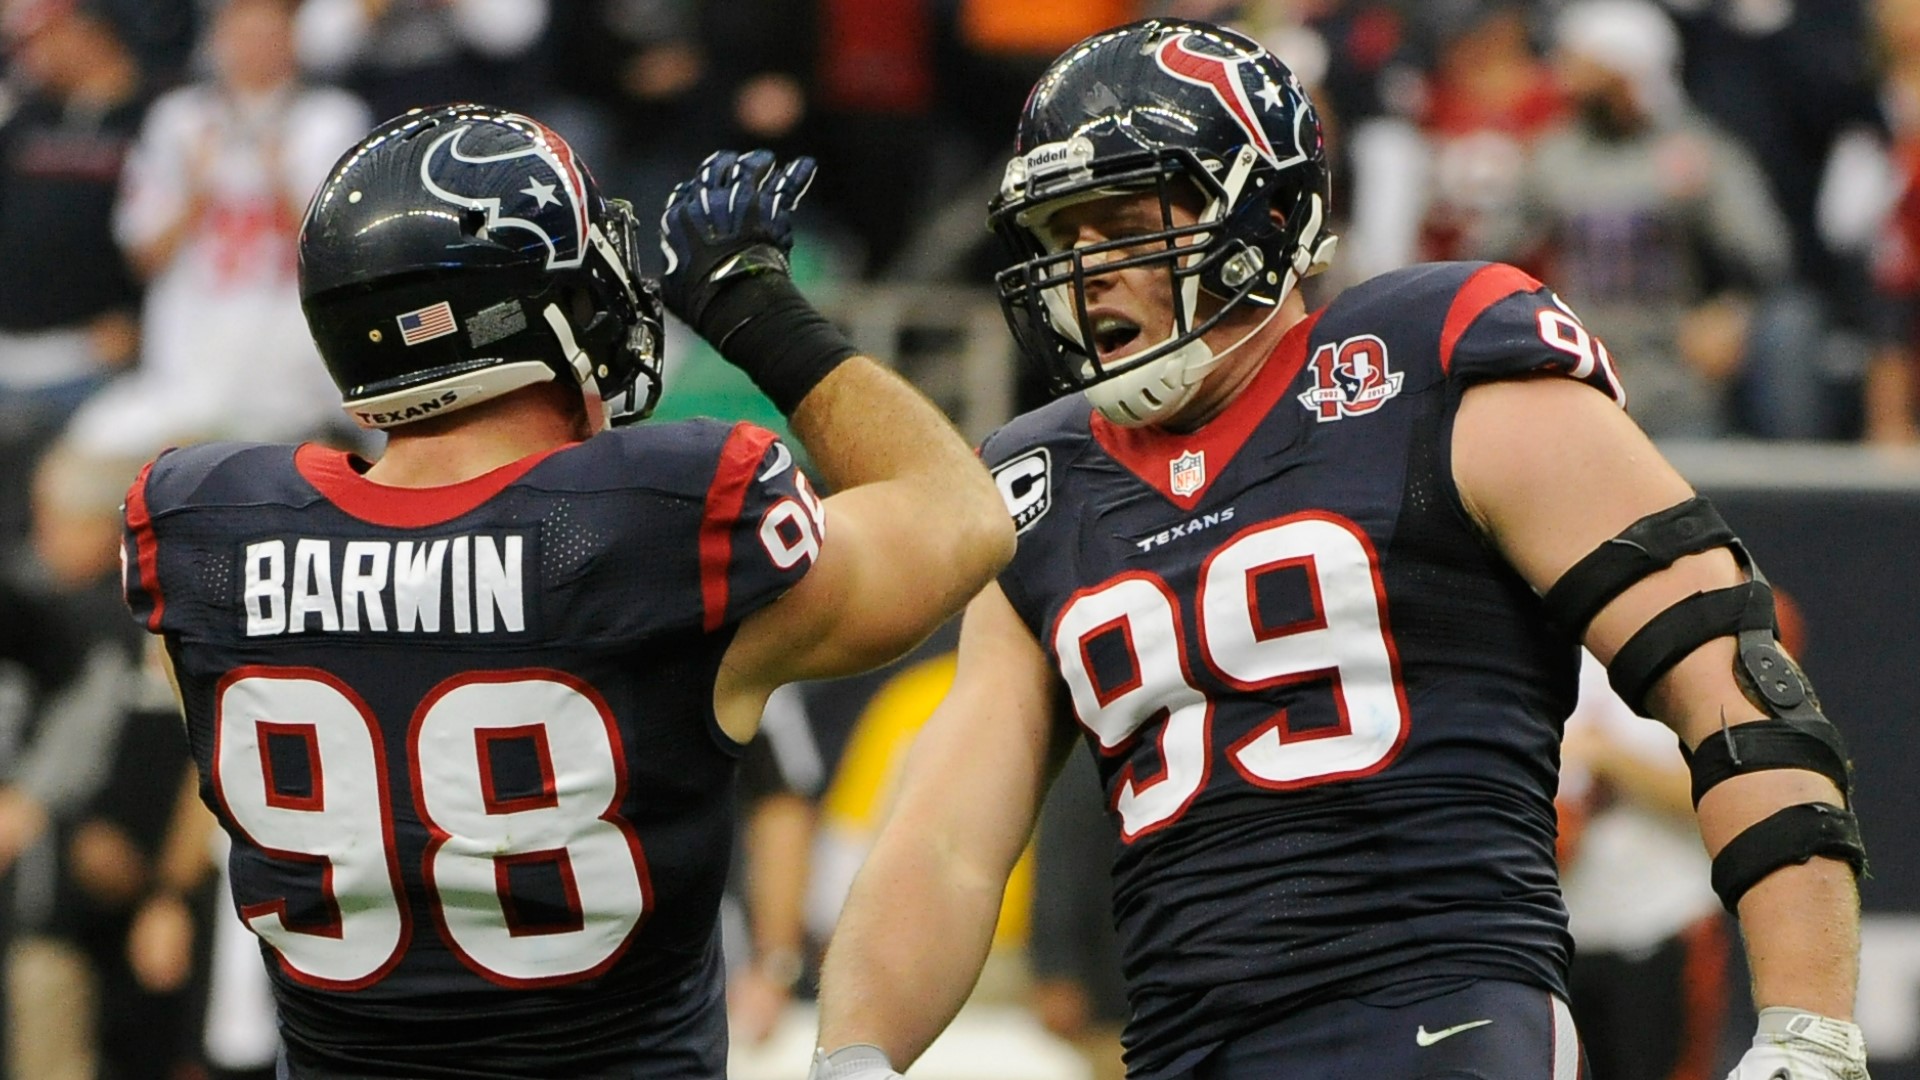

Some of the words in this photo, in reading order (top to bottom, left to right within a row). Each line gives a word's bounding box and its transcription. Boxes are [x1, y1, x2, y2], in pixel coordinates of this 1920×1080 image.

[1027, 148, 1067, 169] Riddell
[1308, 334, 1388, 422] 10
[1367, 387, 1386, 399] 2012
[355, 390, 458, 424] TEXANS
[995, 456, 1046, 517] C
[1176, 468, 1200, 489] NFL
[1136, 507, 1235, 552] TEXANS
[244, 534, 525, 636] BARWIN
[1053, 508, 1412, 845] 99
[213, 665, 654, 992] 98
